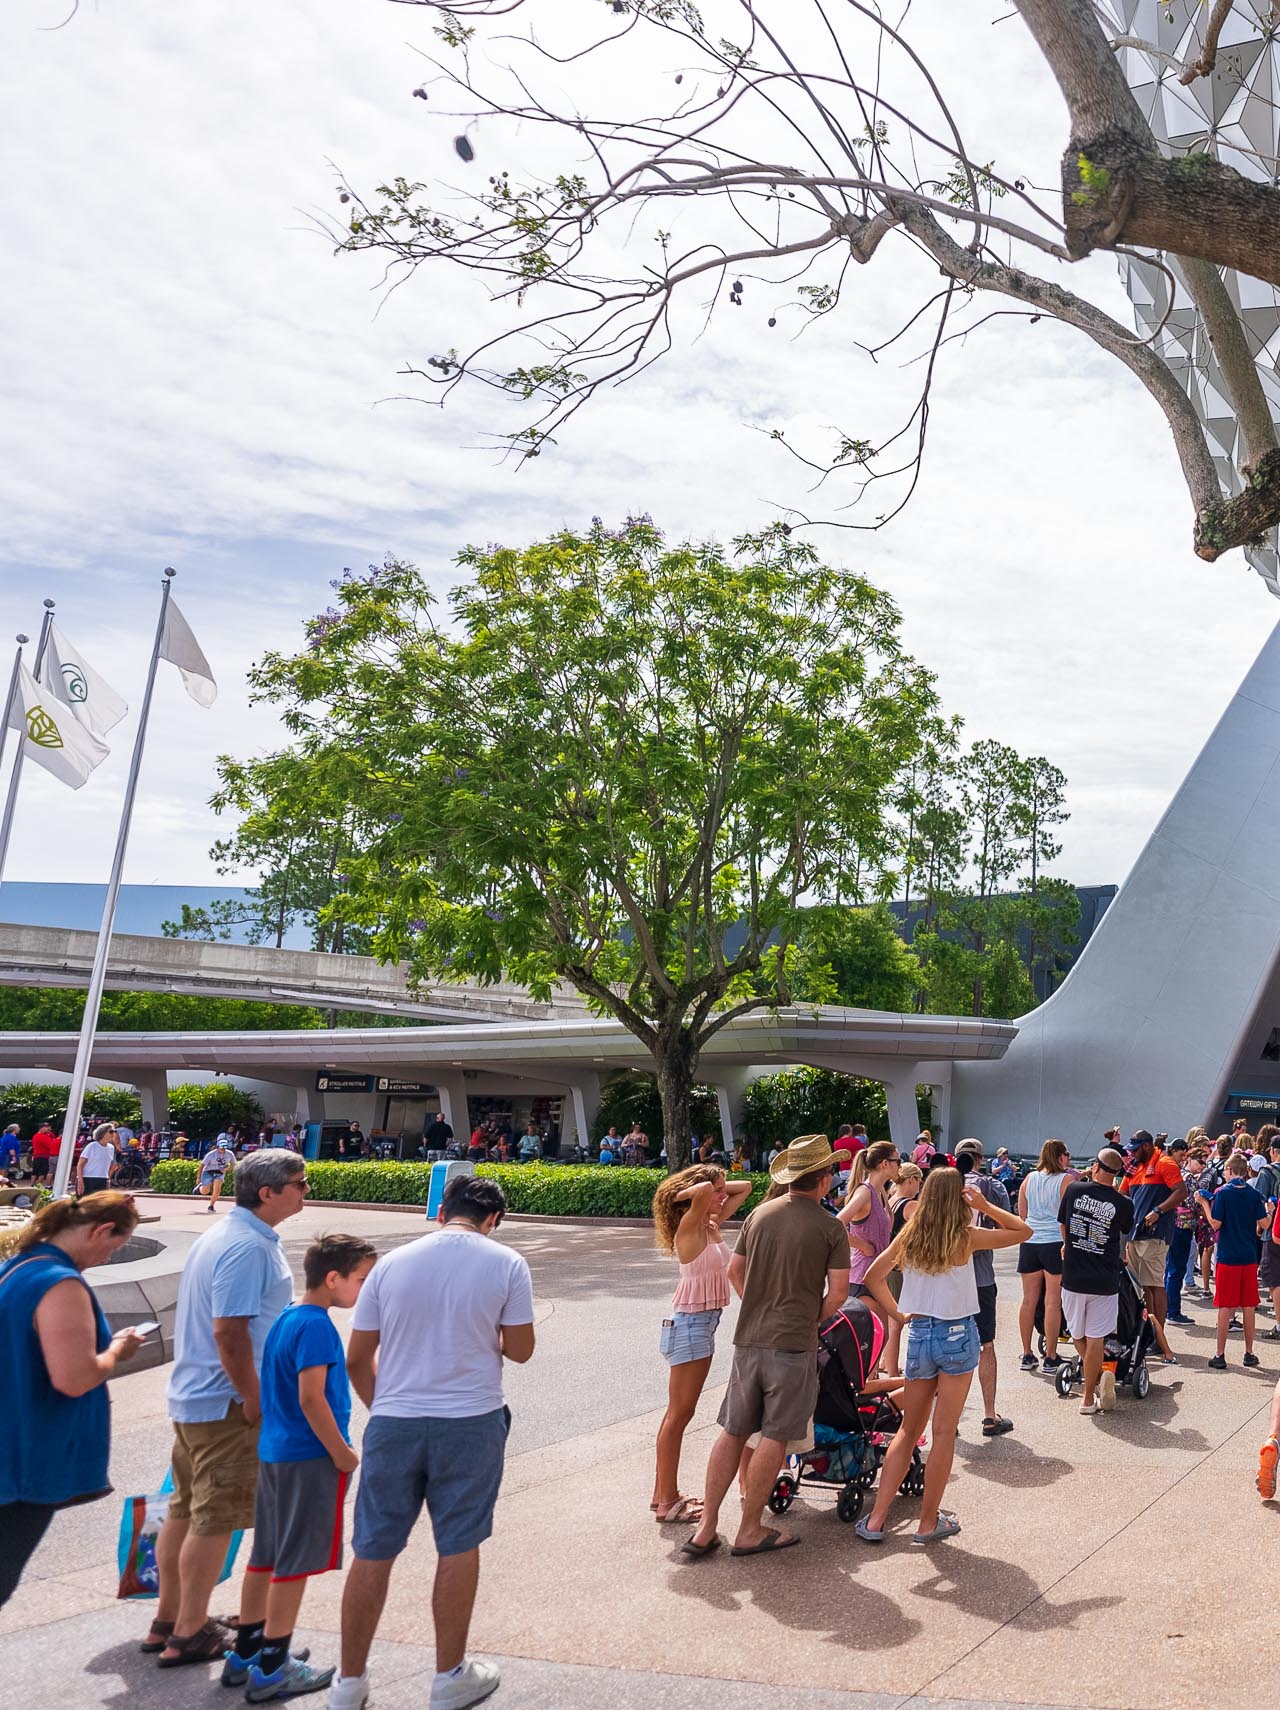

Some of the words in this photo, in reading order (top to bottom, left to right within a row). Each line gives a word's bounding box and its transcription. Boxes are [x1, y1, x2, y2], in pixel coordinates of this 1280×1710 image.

[1240, 1099, 1263, 1108] GATEWAY
[1263, 1101, 1278, 1109] GIFTS
[1082, 1195, 1102, 1208] STATE
[1074, 1199, 1113, 1219] CHAMPIONS
